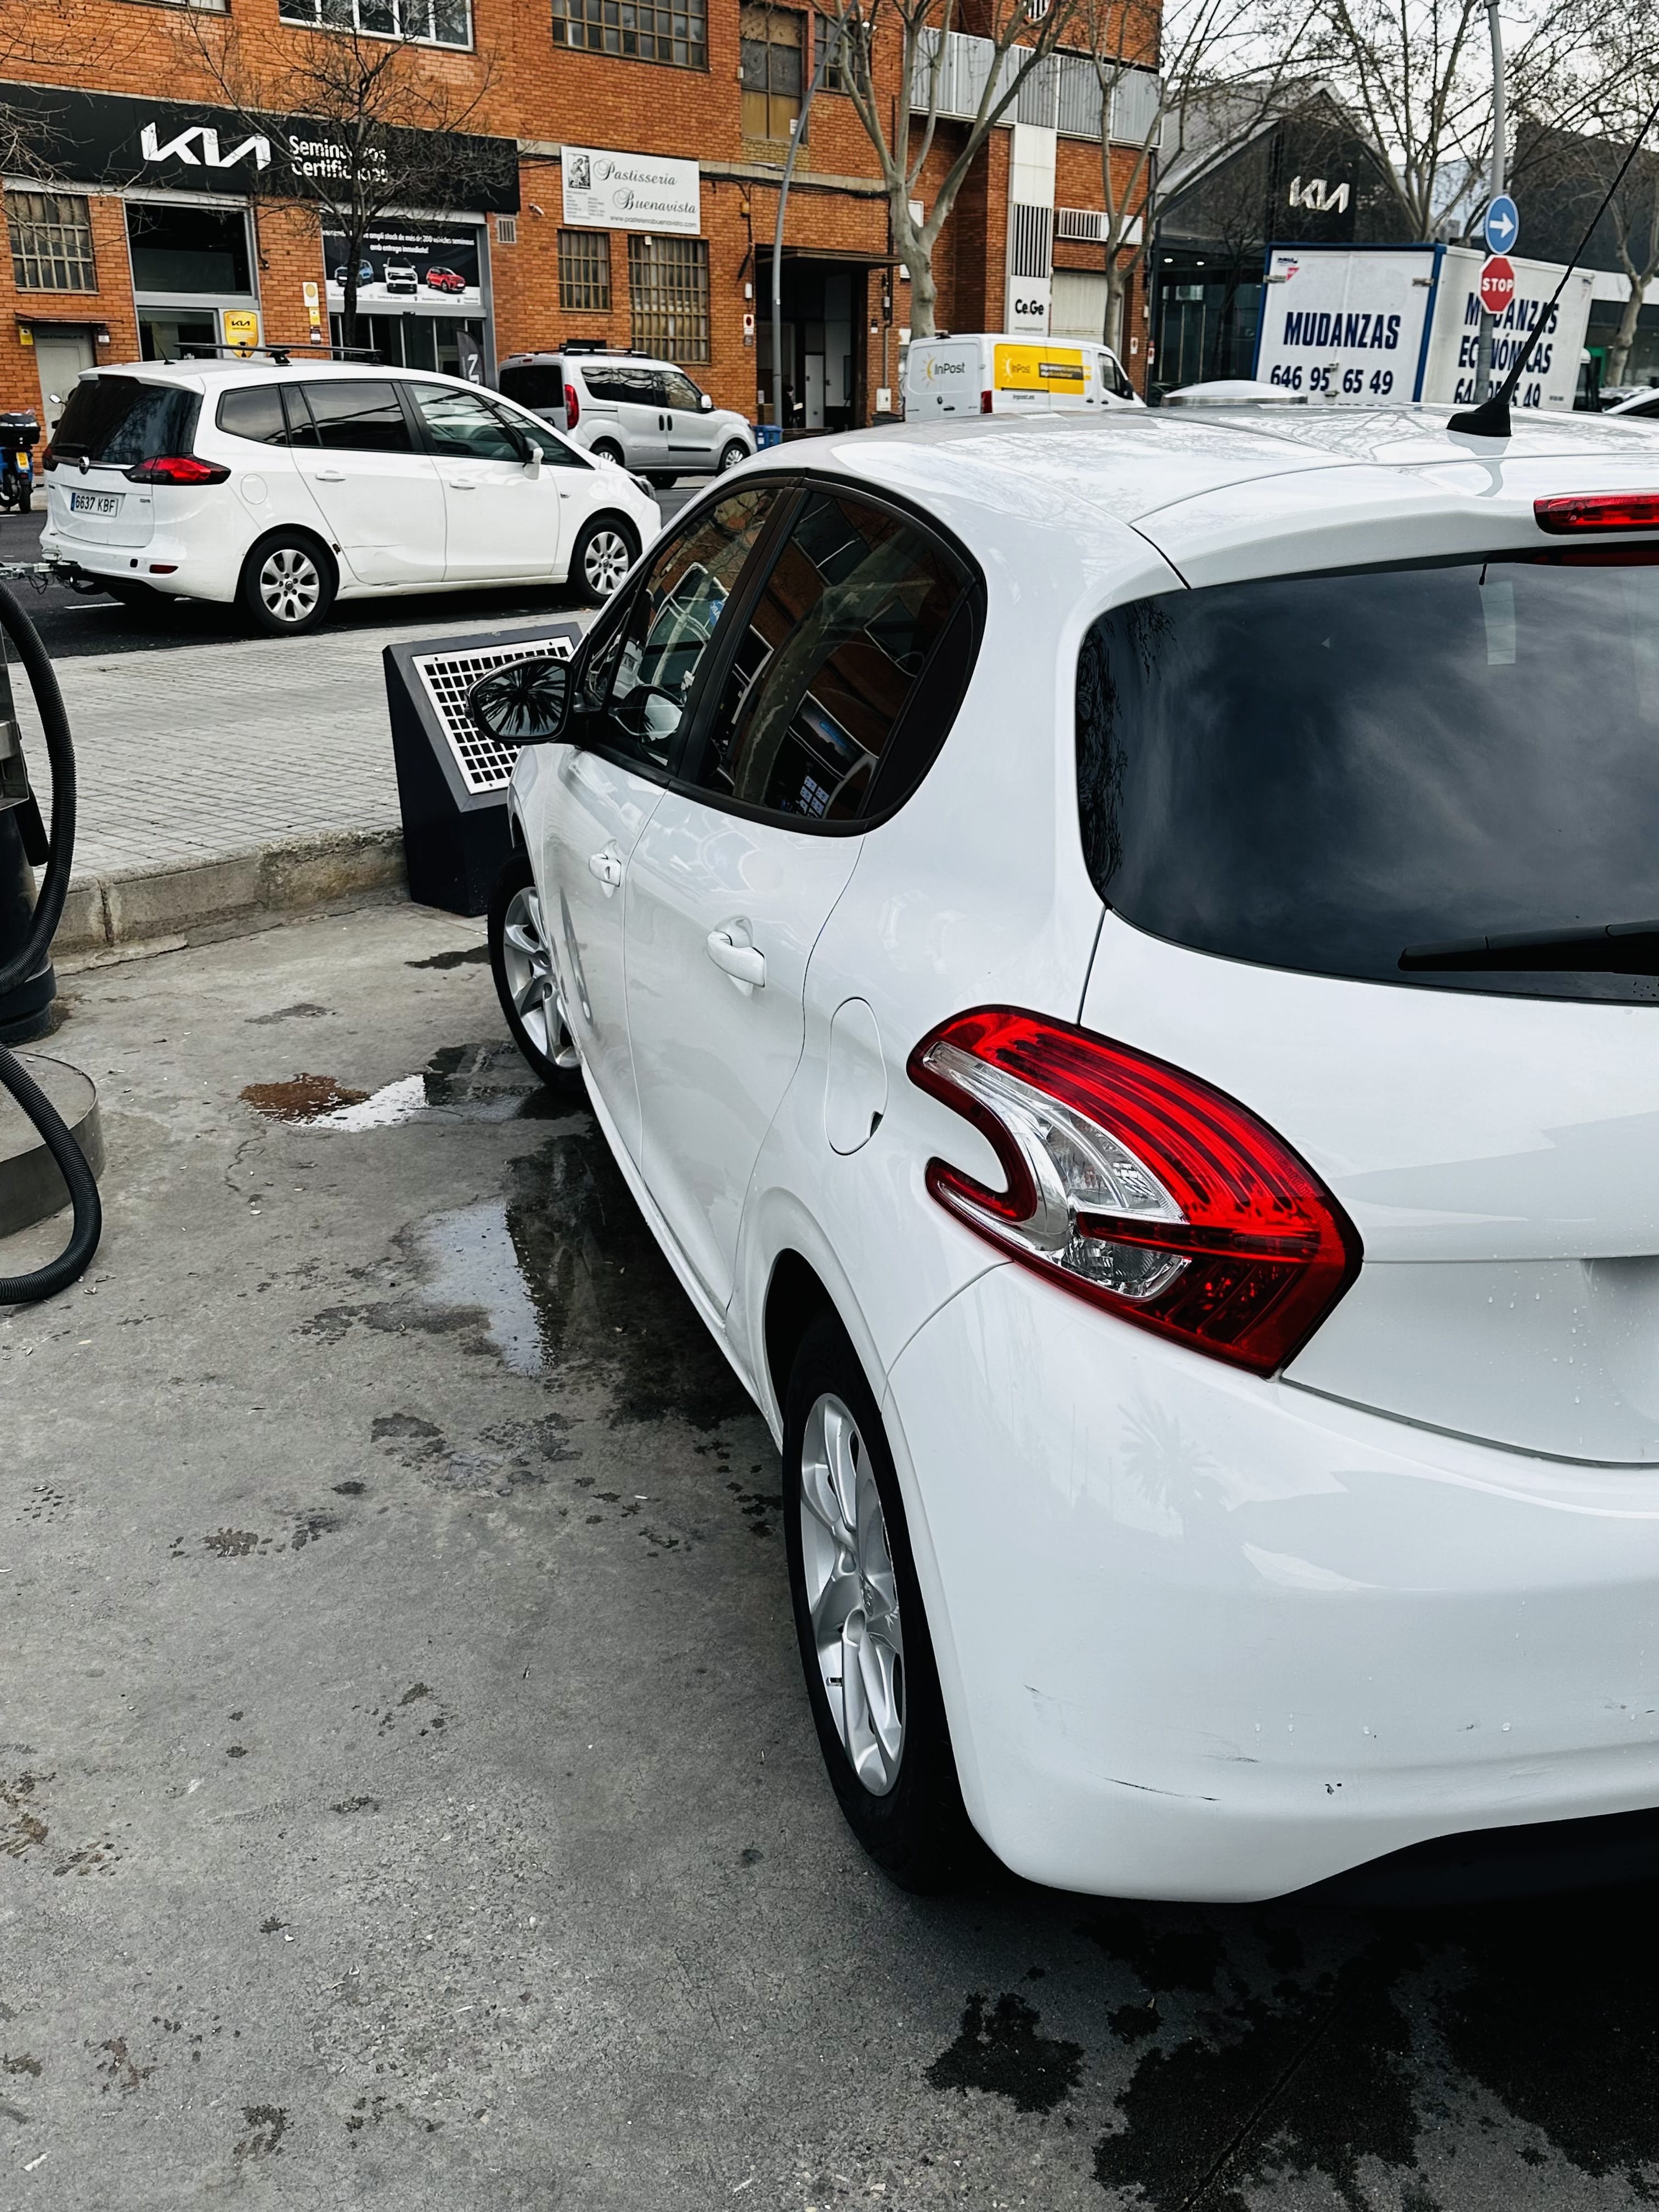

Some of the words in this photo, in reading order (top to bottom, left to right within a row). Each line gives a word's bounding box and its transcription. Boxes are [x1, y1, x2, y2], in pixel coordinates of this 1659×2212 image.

[140, 122, 271, 171] KIA
[593, 158, 678, 186] Pastisseria
[612, 187, 697, 214] Buenavista
[1289, 176, 1350, 213] KIA
[1482, 277, 1514, 292] STOP
[1465, 292, 1559, 334] MANZS
[1283, 312, 1401, 349] MUDANZAS
[1458, 332, 1553, 374] ECNÓMCAS
[934, 362, 966, 375] InPost
[1012, 363, 1031, 374] InPost
[1271, 365, 1302, 391] 646
[1310, 367, 1331, 391] 95
[1343, 369, 1364, 393] 65
[1369, 370, 1393, 395] 49
[1454, 378, 1474, 404] 64
[76, 495, 95, 511] 6637
[97, 498, 115, 514] KBF
